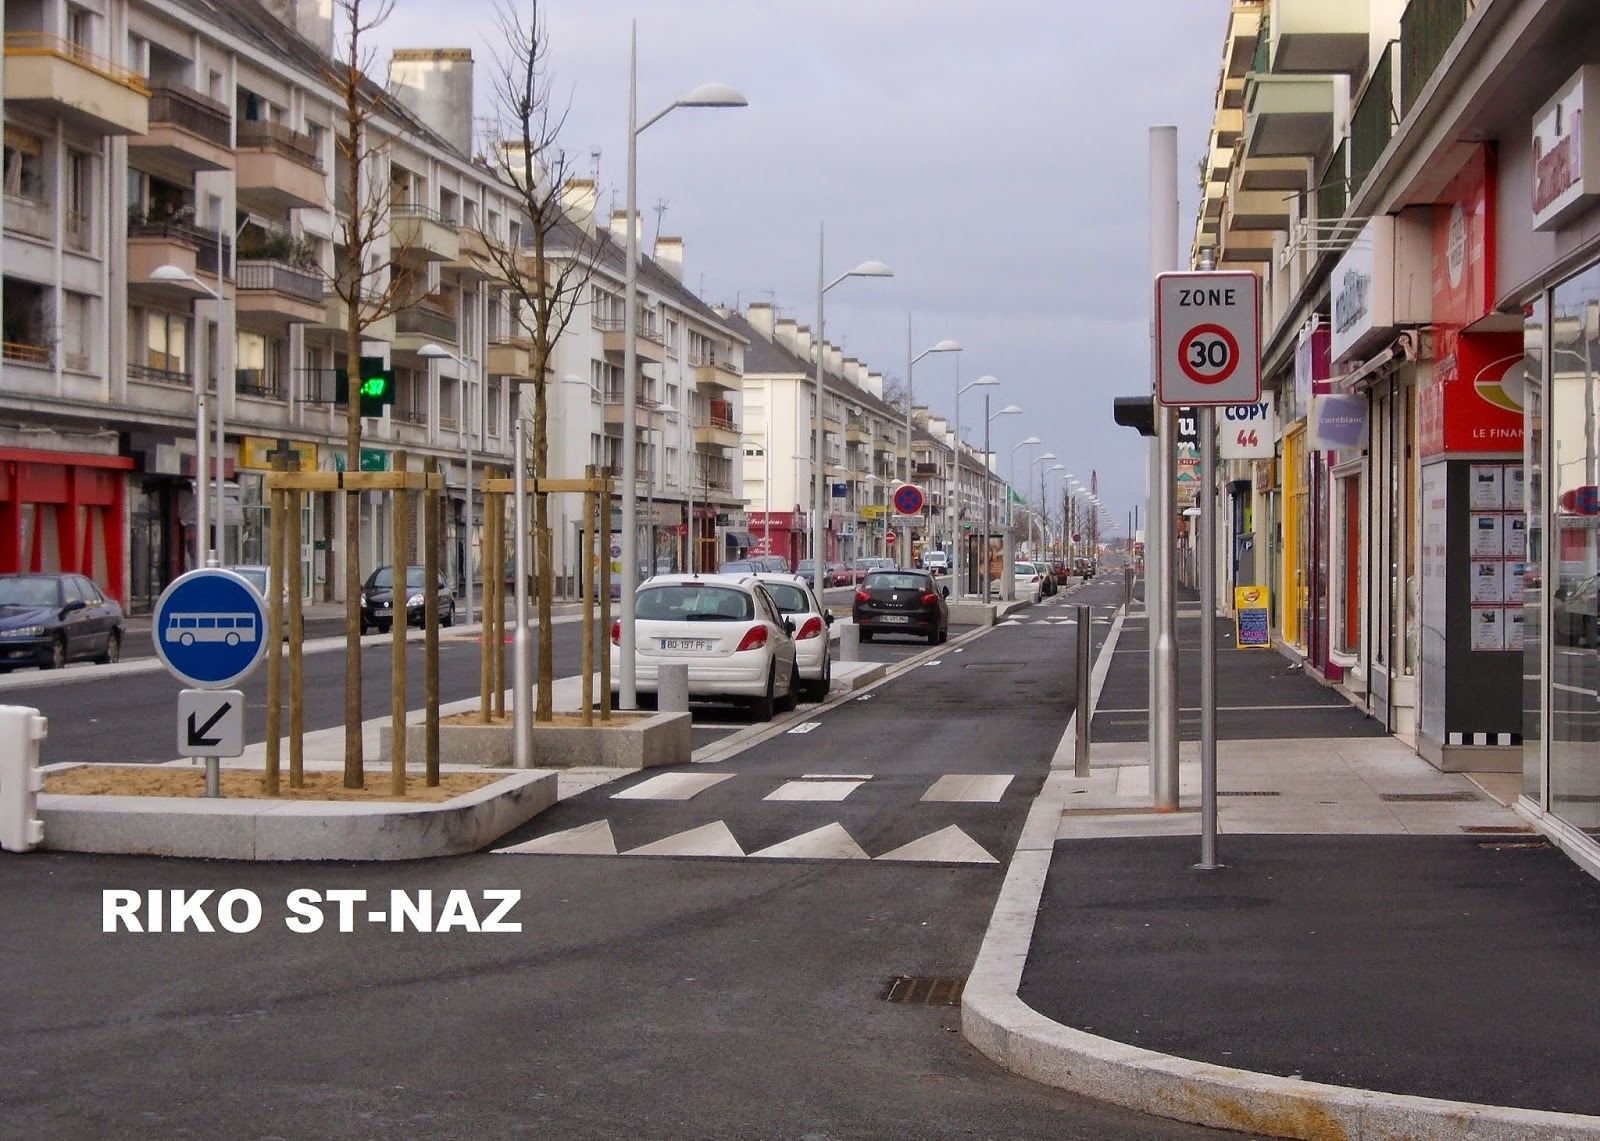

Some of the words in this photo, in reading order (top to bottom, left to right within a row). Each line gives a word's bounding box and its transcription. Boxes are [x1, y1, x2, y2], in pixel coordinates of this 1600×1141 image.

[1179, 288, 1236, 307] ZONE
[1189, 340, 1228, 368] 30
[1225, 402, 1269, 420] COPY
[1236, 429, 1259, 447] 44
[1473, 429, 1486, 438] LE
